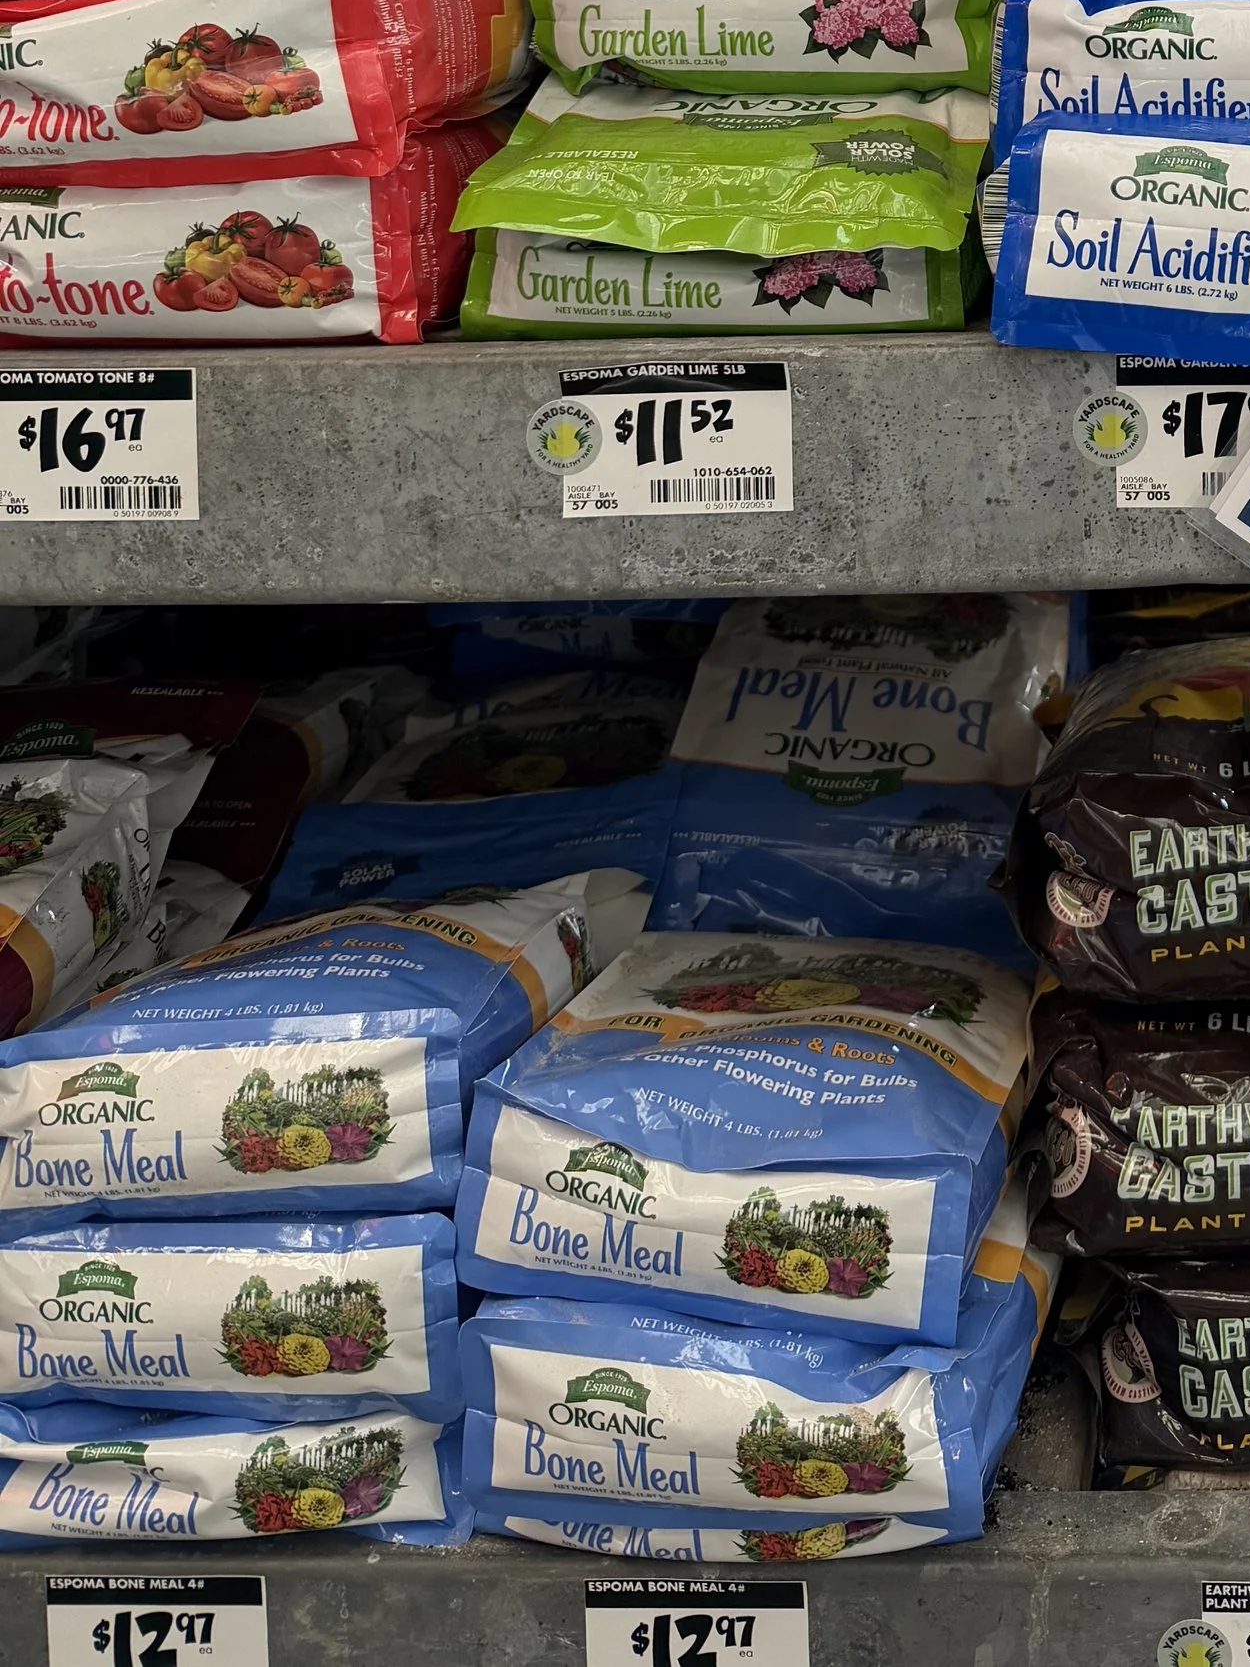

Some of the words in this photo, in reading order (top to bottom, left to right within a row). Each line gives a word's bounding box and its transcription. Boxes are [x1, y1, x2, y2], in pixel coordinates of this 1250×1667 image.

[579, 5, 687, 57] Garden
[697, 6, 775, 57] Lime
[1085, 34, 1215, 61] ORGANIC
[1110, 175, 1248, 213] ORGANIC
[1047, 209, 1118, 274] Soil
[517, 246, 630, 308] Garden
[641, 255, 722, 309] Lime
[37, 373, 94, 383] TOMATO
[97, 372, 134, 383] TONE
[139, 372, 155, 383] 8#
[563, 367, 623, 382] ESPOMA
[627, 365, 684, 377] GARDEN
[689, 364, 718, 375] LIME
[723, 364, 746, 375] 5LB
[1120, 357, 1176, 368] ESPOMA
[101, 476, 179, 484] 0000-776-436
[693, 466, 772, 477] 1010-654-062
[1218, 762, 1234, 778] 6
[713, 1059, 815, 1106] Flowering
[820, 1092, 886, 1104] Plants
[38, 1100, 152, 1128] ORGANIC
[14, 1129, 93, 1189] Bone
[101, 1128, 187, 1184] Meal
[546, 1170, 655, 1220] ORGANIC
[508, 1184, 591, 1259] Bone
[600, 1212, 684, 1278] Meal
[1125, 1211, 1245, 1233] PLANT
[17, 1323, 98, 1379] Bone
[104, 1329, 190, 1379] Meal
[548, 1402, 665, 1441] ORGANIC
[524, 1420, 607, 1486] Bone
[616, 1441, 701, 1496] Meal
[50, 1578, 105, 1590] ESPOMA
[109, 1579, 145, 1590] BONE
[150, 1579, 184, 1590] MEAL
[188, 1579, 204, 1589] 4#
[1206, 1598, 1248, 1609] PLANT
